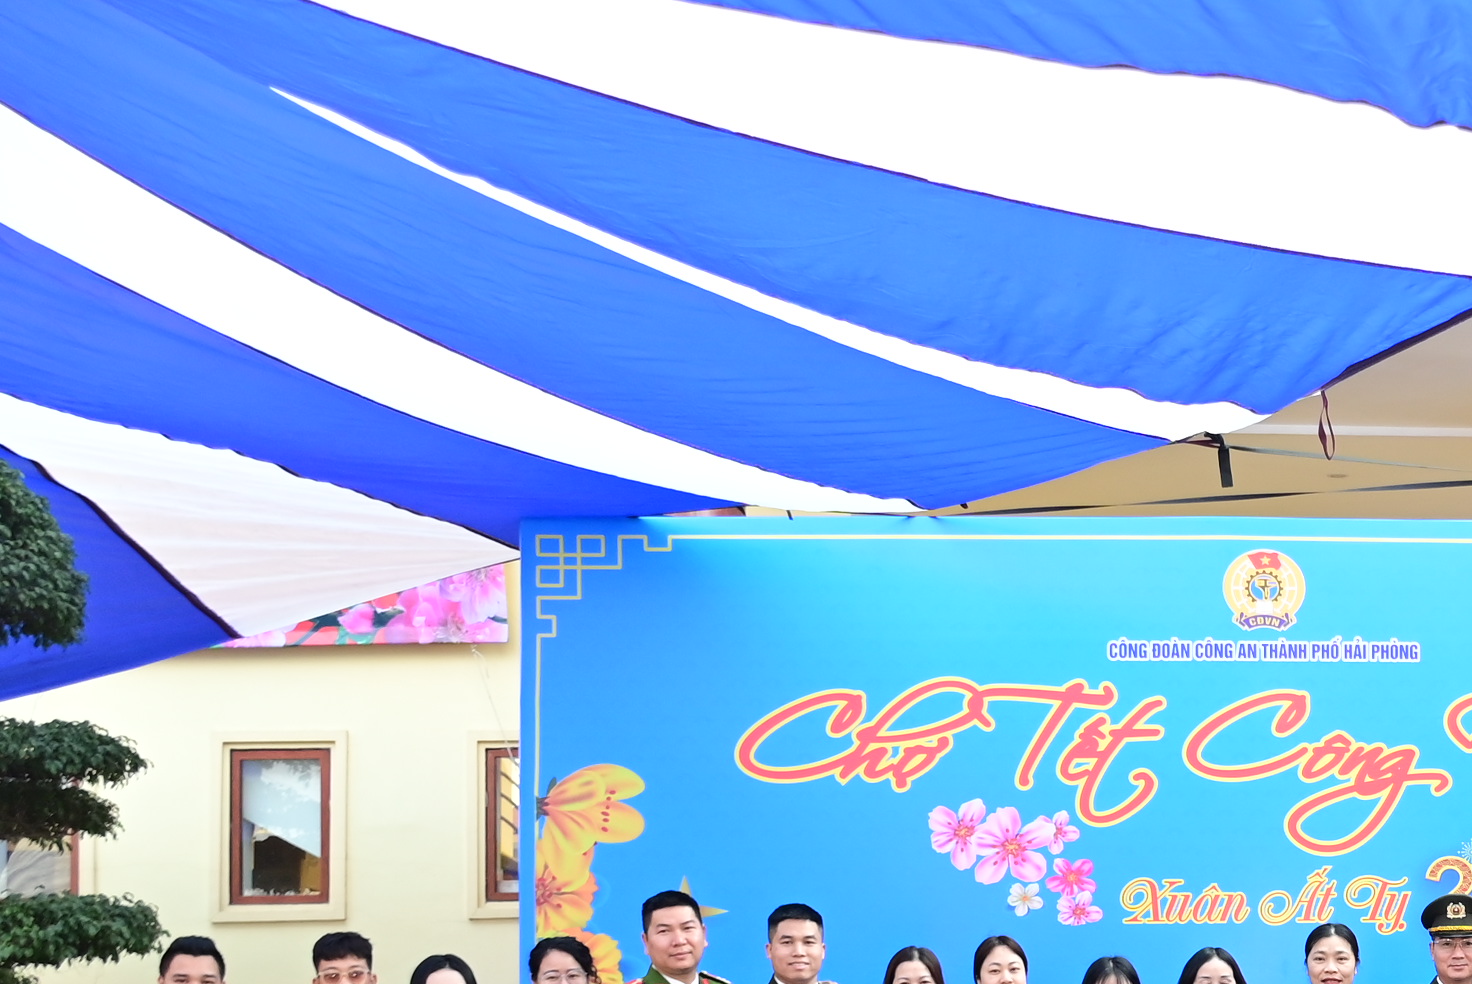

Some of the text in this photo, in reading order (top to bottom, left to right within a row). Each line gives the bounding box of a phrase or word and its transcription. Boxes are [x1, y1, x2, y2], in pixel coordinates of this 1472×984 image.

[1108, 636, 1419, 661] CÔNG ĐOÀN CÔNG AN THÀNH PHỐ HẢI PHÒNG
[735, 676, 996, 793] Chợ
[976, 678, 1166, 828] Tết
[1182, 688, 1452, 856] Công
[1121, 866, 1412, 936] Xuân Ất Tỵ
